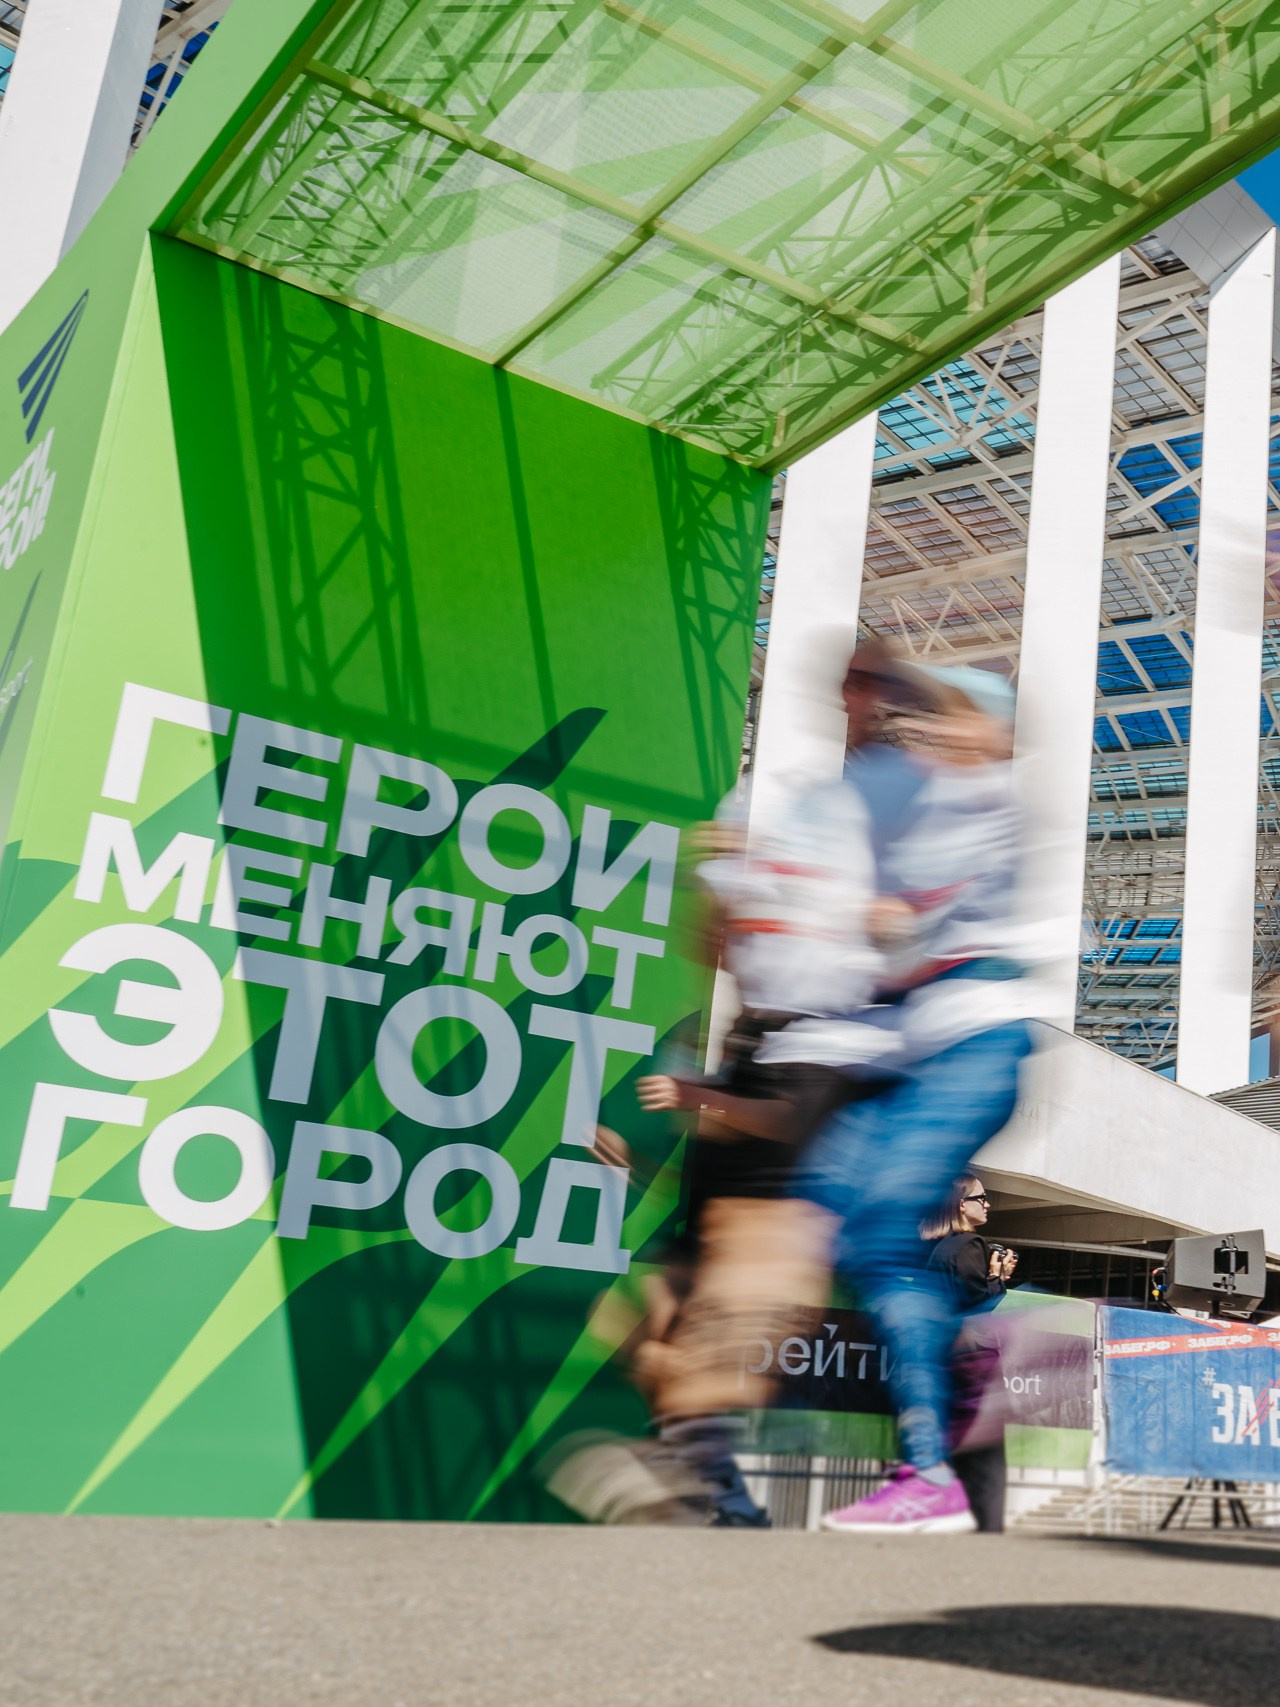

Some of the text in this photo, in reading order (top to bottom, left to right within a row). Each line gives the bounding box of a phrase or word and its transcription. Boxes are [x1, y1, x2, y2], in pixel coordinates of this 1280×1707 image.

[101, 682, 681, 926] ГЕРОИ
[73, 812, 666, 1010] МЕНЯЮТ
[48, 923, 656, 1149] ЭТОТ
[9, 1082, 632, 1274] ГОРОД
[737, 1323, 899, 1390] рейти
[1003, 1375, 1041, 1396] ort
